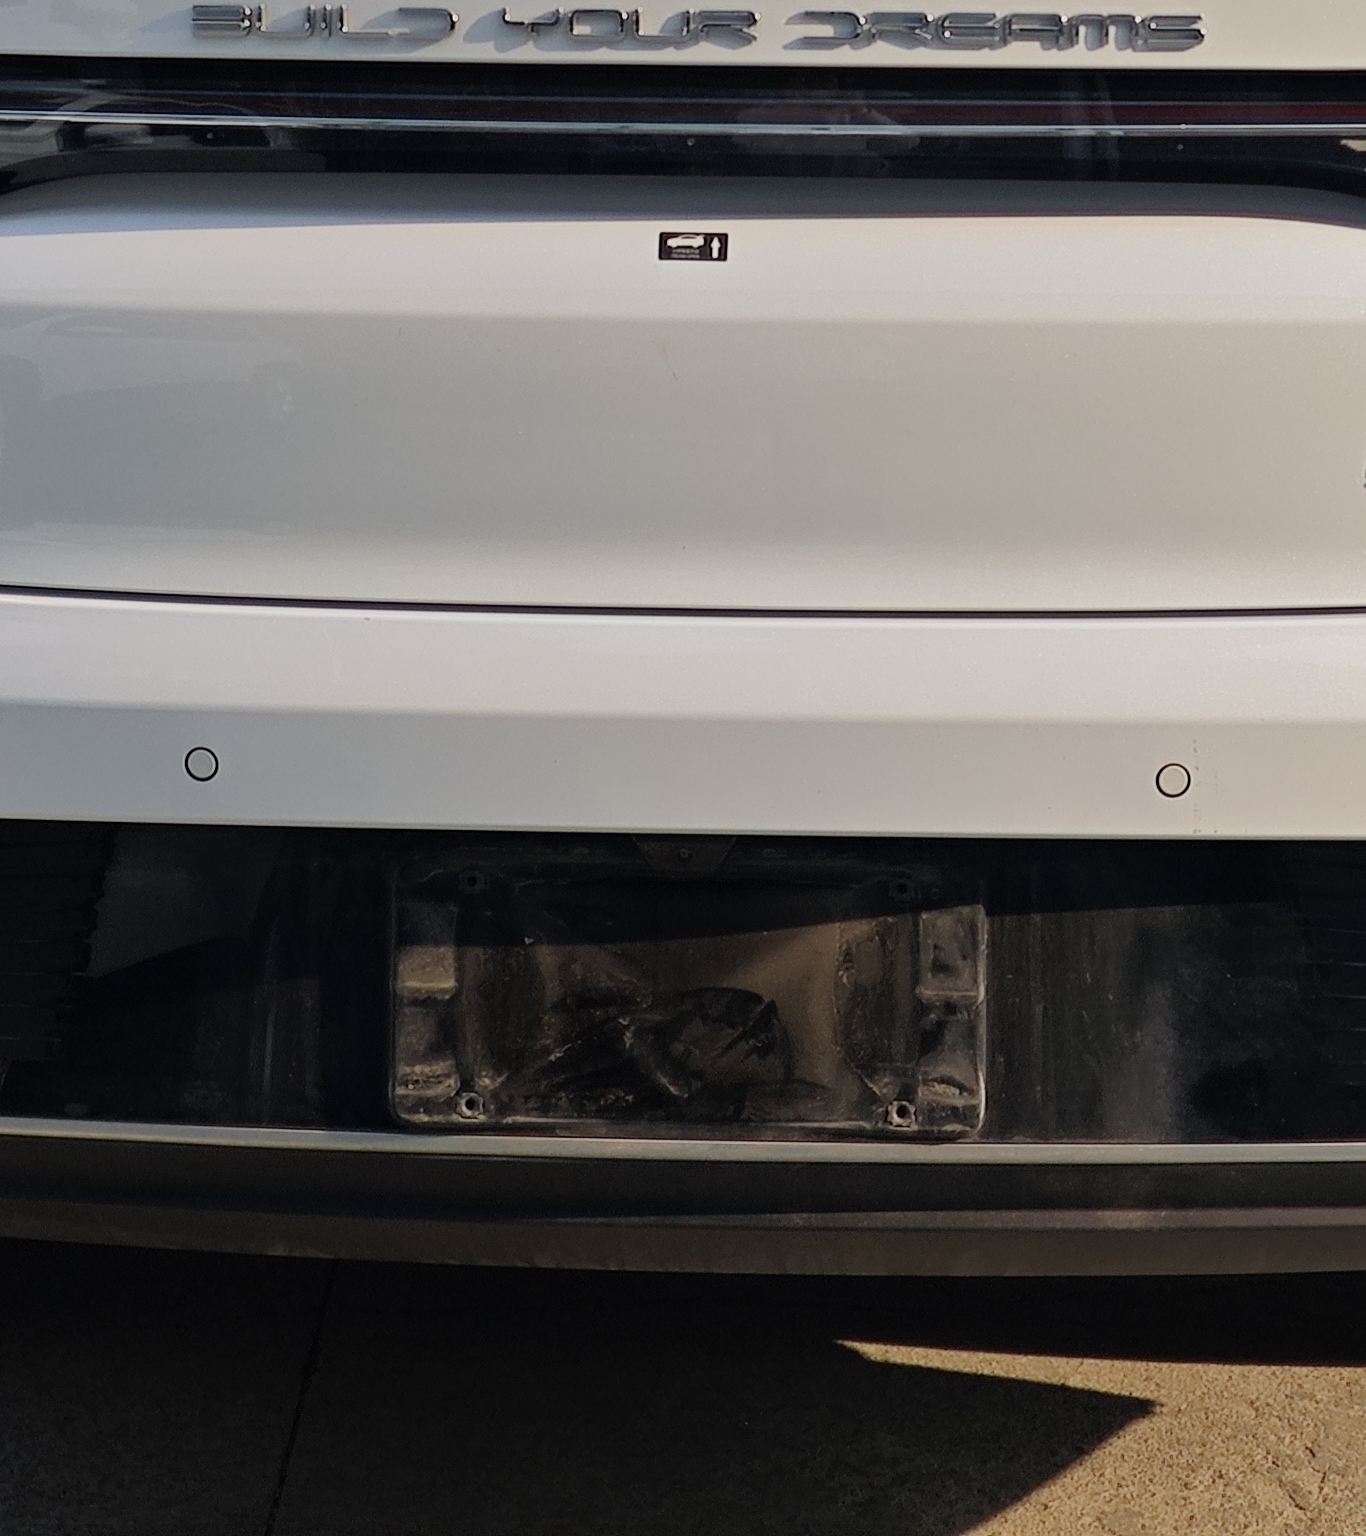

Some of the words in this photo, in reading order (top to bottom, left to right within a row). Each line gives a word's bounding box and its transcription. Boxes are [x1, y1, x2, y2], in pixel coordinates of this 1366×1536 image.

[192, 3, 459, 40] BUILD
[501, 6, 761, 44] YOUR
[784, 9, 1208, 52] DREAMS
